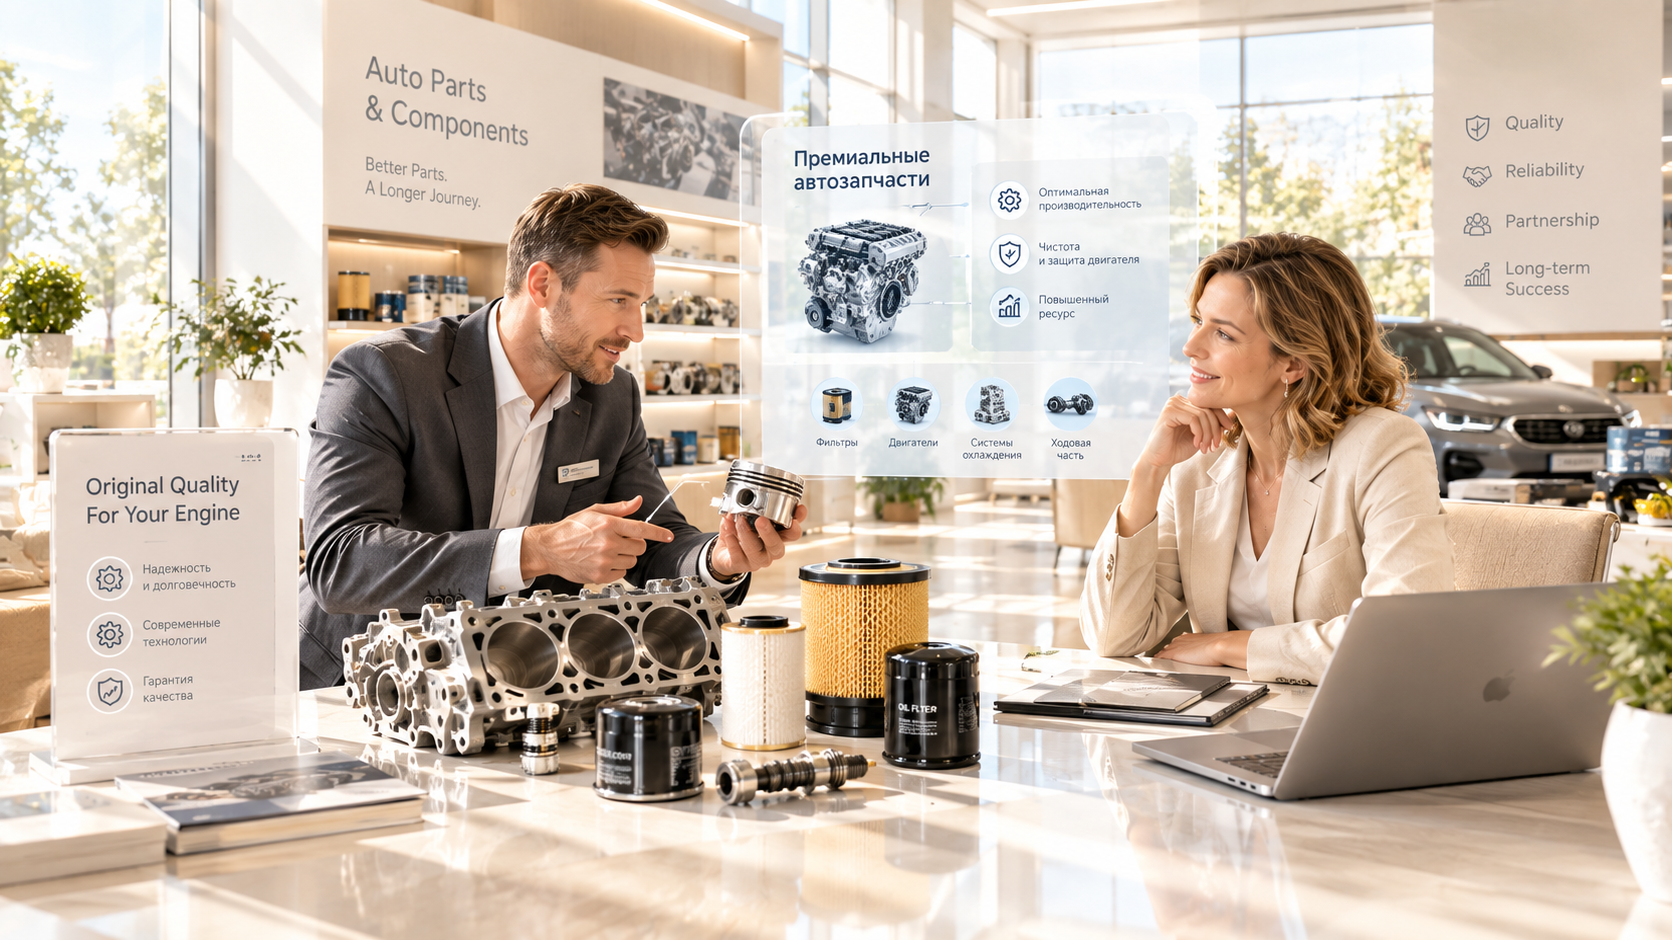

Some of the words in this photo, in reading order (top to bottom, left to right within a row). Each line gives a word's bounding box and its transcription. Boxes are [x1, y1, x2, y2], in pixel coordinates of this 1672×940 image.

[366, 56, 422, 89] Auto
[432, 69, 486, 102] Parts
[366, 95, 383, 122] &
[391, 101, 528, 145] Components
[1505, 114, 1563, 131] Quality
[794, 150, 930, 169] Премиальные
[365, 156, 407, 175] Better
[412, 163, 447, 181] Parts.
[1505, 162, 1584, 179] Reliability
[794, 173, 930, 190] автозапчасти
[365, 180, 375, 194] A
[380, 182, 426, 203] Longer
[430, 188, 480, 210] Journey.
[1039, 188, 1109, 197] Оптимальная
[1039, 201, 1142, 212] производительность
[1505, 212, 1599, 229] Partnership
[1038, 243, 1080, 251] Чистота
[1048, 258, 1085, 266] защита
[1088, 257, 1139, 266] двигателя
[1505, 261, 1590, 278] Long-term
[1505, 282, 1569, 296] Success
[1039, 295, 1109, 304] Повышенный
[1039, 311, 1075, 320] ресурс
[815, 437, 858, 448] Фильтры
[889, 438, 938, 448] Двигатели
[971, 438, 1013, 447] Системы
[1052, 439, 1091, 448] Ходовая
[963, 452, 1021, 460] охлаждения
[1056, 452, 1085, 461] часть
[86, 475, 163, 498] Original
[171, 475, 239, 497] Quality
[87, 506, 119, 524] For
[125, 506, 169, 523] Your
[176, 504, 239, 525] Engine
[143, 564, 211, 575] Надежность
[153, 580, 236, 592] долговечность
[143, 620, 220, 632] Современные
[142, 637, 207, 647] технологии
[144, 676, 193, 688] Гарантия
[143, 692, 193, 703] качества
